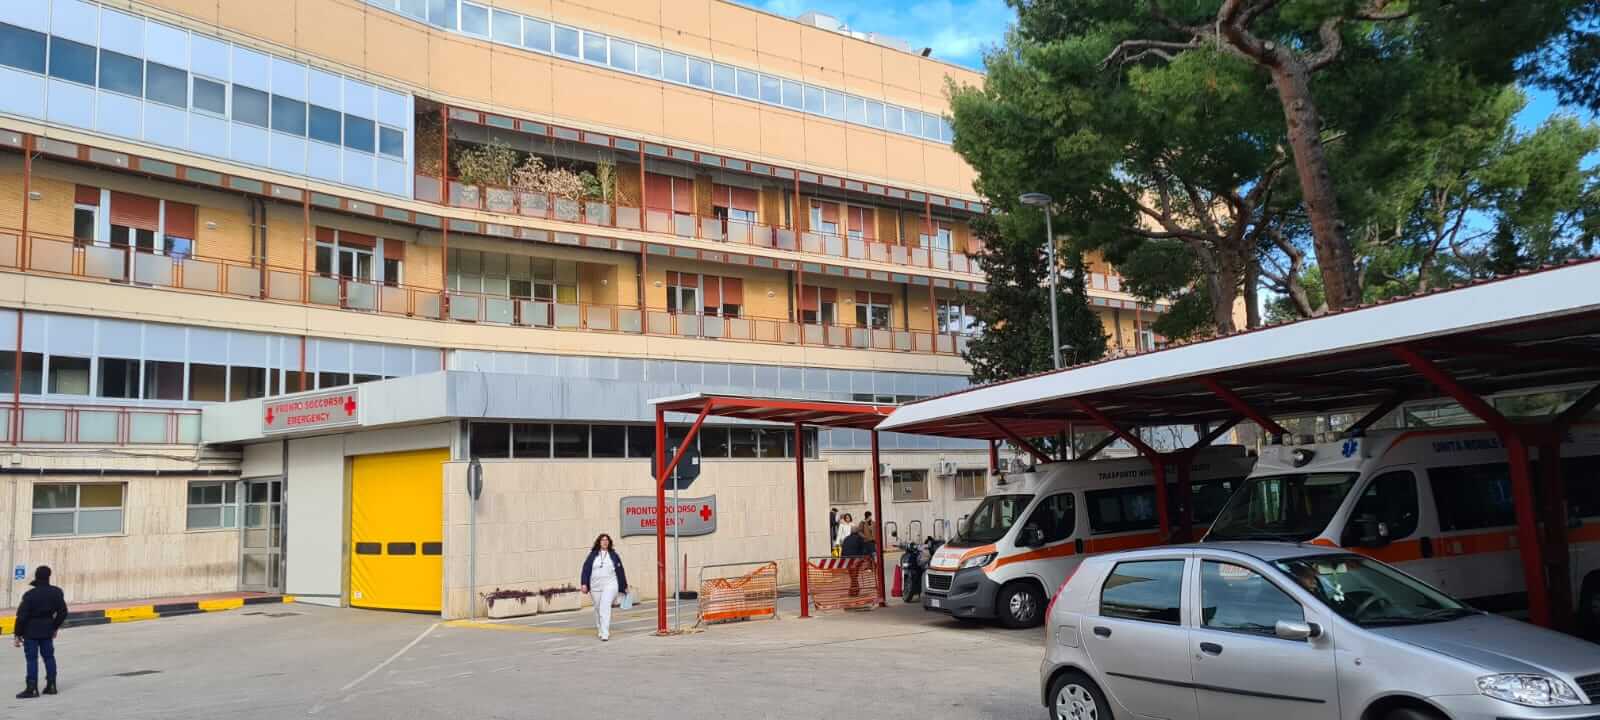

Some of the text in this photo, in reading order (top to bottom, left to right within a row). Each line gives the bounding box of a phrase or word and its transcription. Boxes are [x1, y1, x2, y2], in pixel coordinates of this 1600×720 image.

[287, 413, 329, 425] EMERGENCY
[660, 504, 697, 514] OCORSO
[640, 519, 684, 527] EMEENY
